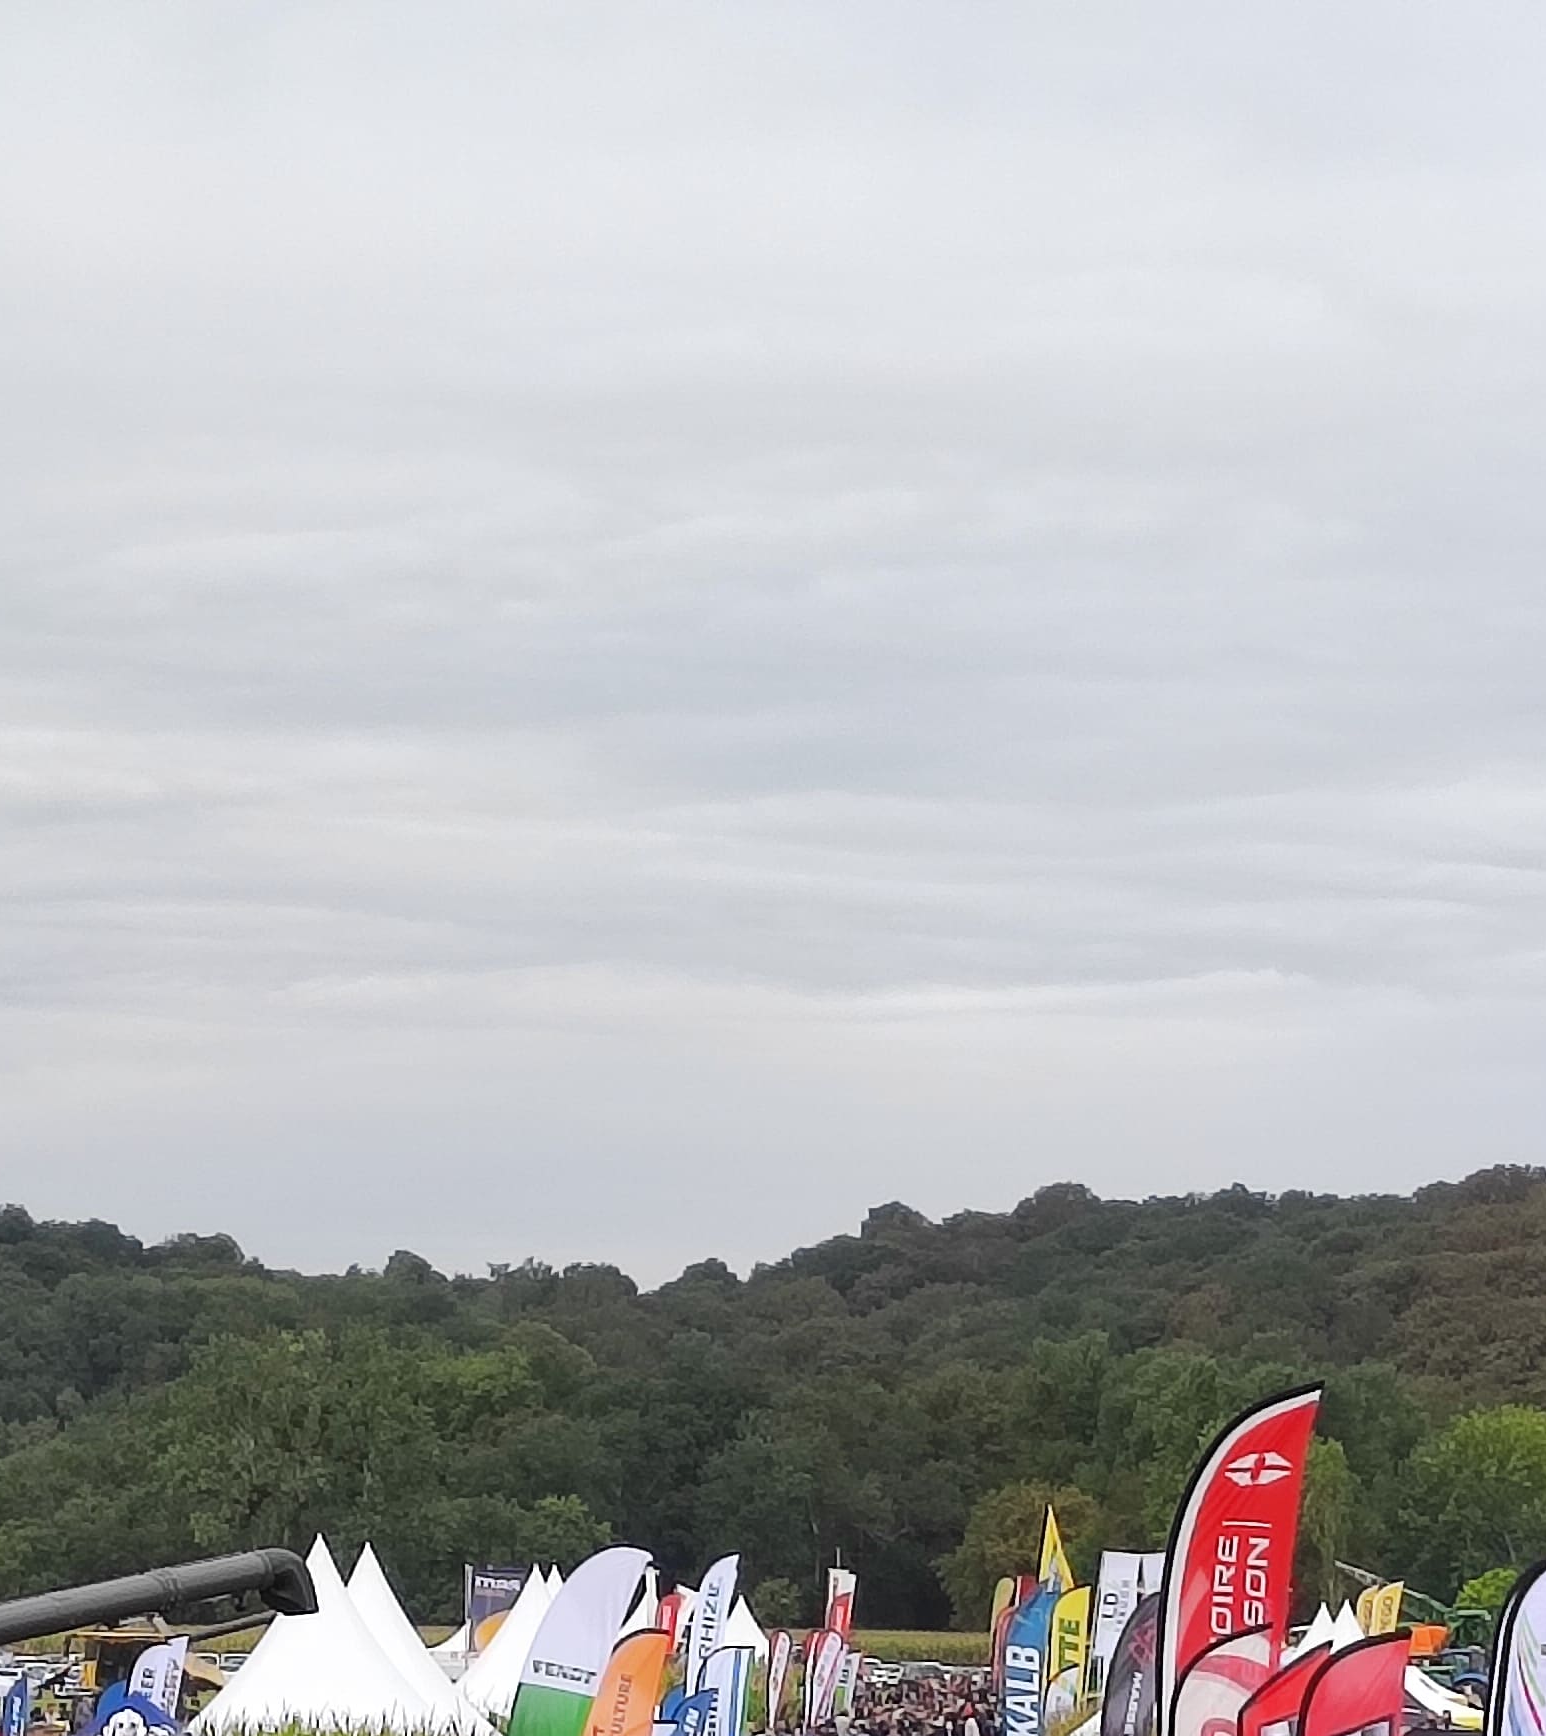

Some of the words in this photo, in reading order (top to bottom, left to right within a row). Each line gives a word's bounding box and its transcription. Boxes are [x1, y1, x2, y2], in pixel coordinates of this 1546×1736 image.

[1209, 1535, 1240, 1644] OIRE
[1243, 1537, 1271, 1627] SON
[532, 1658, 597, 1685] FENDT
[1058, 1617, 1081, 1671] TTE
